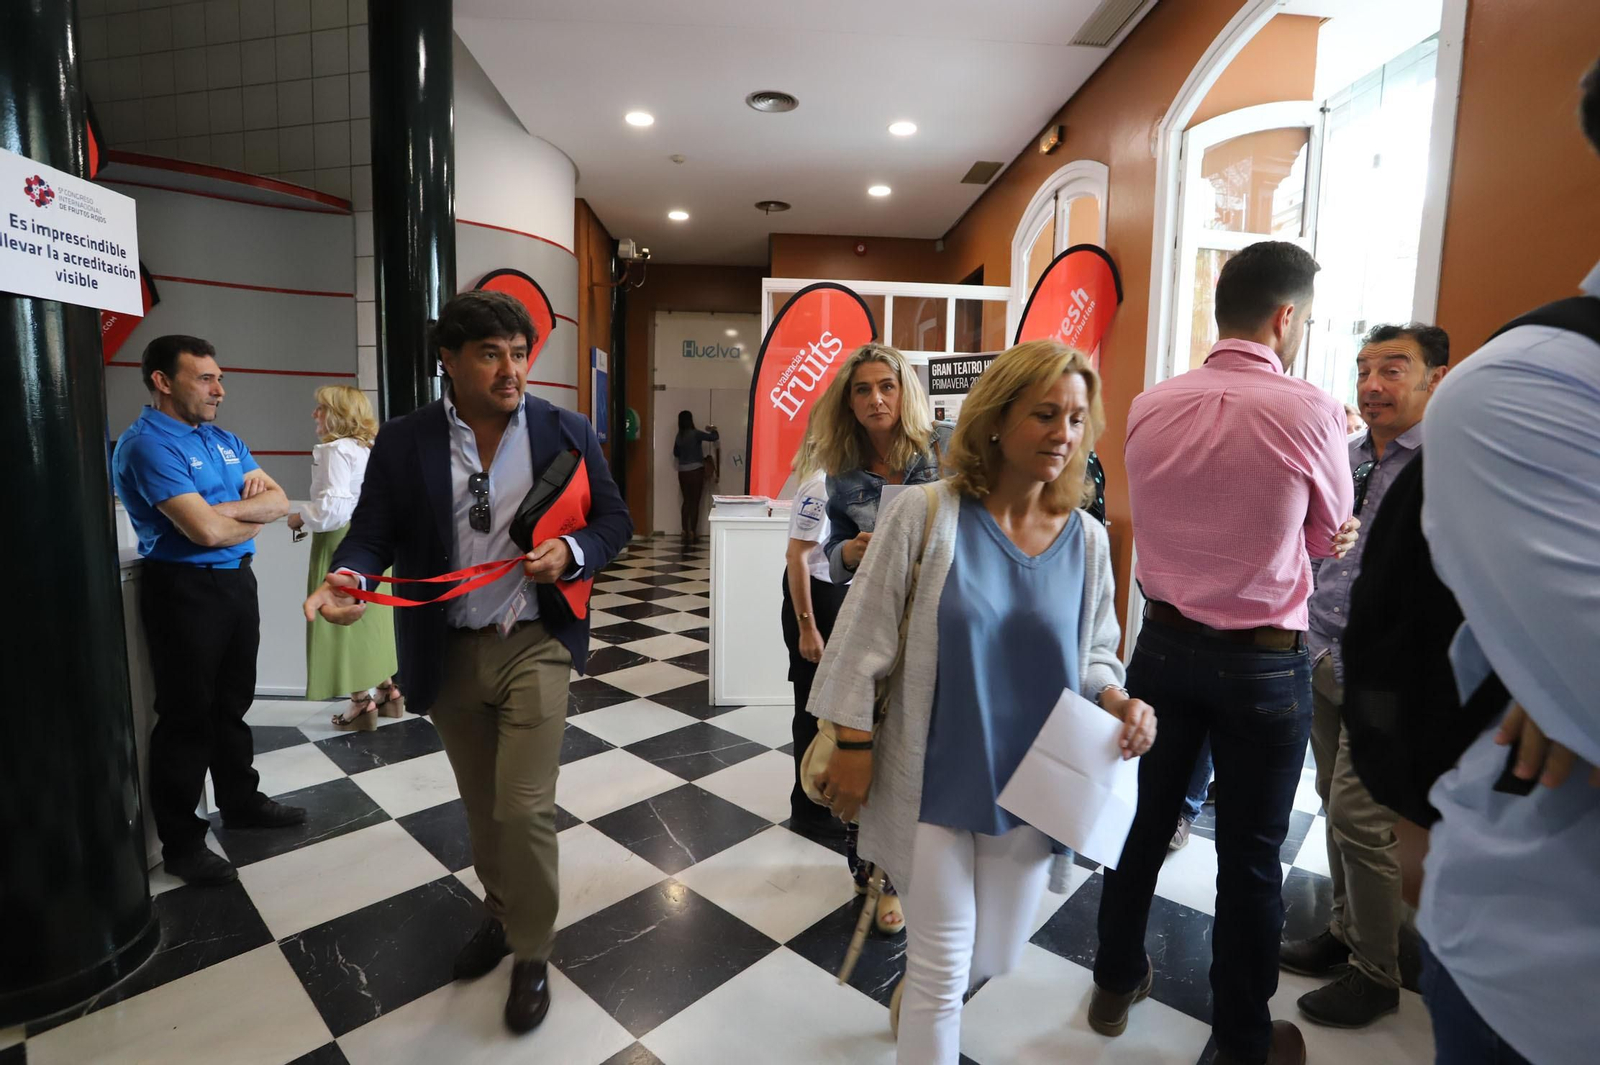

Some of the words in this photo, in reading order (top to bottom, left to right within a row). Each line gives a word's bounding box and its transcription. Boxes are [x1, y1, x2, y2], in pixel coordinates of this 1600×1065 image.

[58, 195, 102, 215] INTERNACIONAL
[64, 189, 94, 205] CONGRESO
[59, 203, 67, 211] DE
[68, 205, 90, 218] FRUTOS
[90, 213, 107, 224] ROJOS
[9, 213, 28, 231] Es
[31, 219, 127, 258] imprescindible
[0, 231, 42, 256] llevar
[47, 244, 59, 260] la
[63, 252, 136, 280] acreditación
[55, 269, 98, 289] visible
[682, 340, 740, 359] Huelva
[769, 330, 843, 421] fruits
[777, 354, 802, 387] valencia
[931, 363, 952, 376] GRAN
[953, 360, 983, 375] TEATRO
[932, 377, 969, 390] PRIMAVERA
